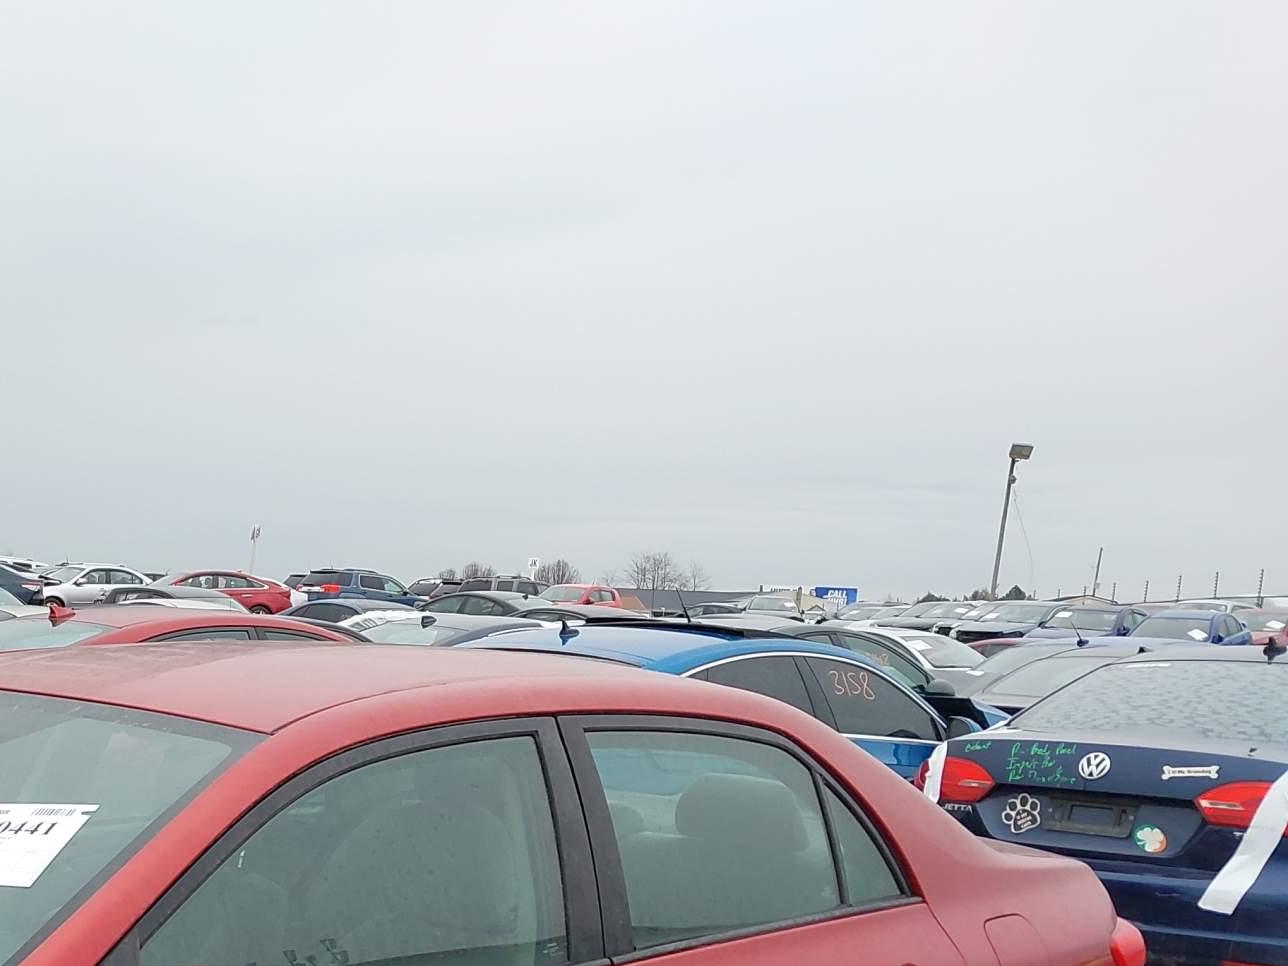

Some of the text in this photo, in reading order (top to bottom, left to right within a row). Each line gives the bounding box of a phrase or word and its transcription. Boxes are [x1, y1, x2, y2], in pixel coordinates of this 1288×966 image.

[827, 590, 847, 598] CALL
[829, 670, 875, 700] 3158
[943, 803, 973, 814] JETTA
